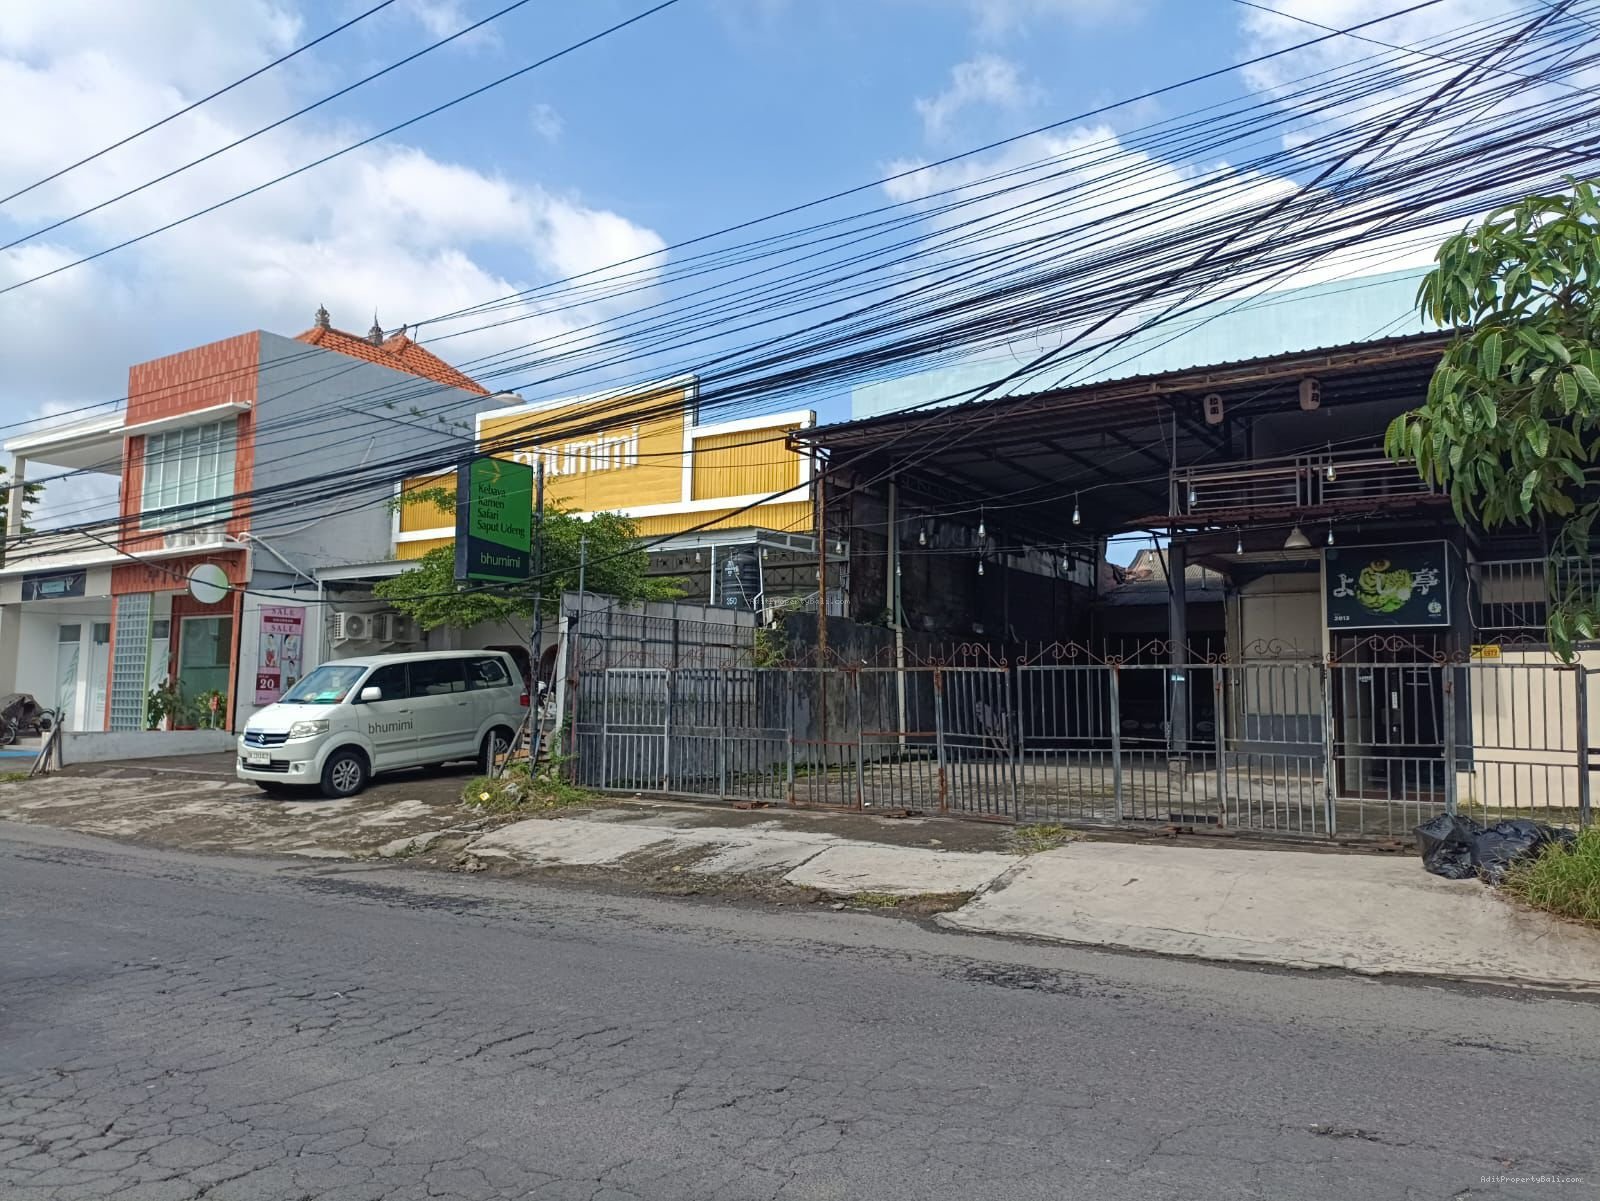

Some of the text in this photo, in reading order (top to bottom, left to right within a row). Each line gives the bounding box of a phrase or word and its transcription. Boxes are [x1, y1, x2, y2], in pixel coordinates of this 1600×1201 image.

[478, 482, 506, 499] Kebaya
[478, 496, 505, 509] Kamen
[477, 508, 499, 520] Safari
[477, 520, 525, 539] Saput Udeng
[480, 551, 521, 569] bhumimi
[272, 608, 296, 616] SALE
[271, 625, 294, 633] SALE
[260, 679, 275, 689] 20
[368, 718, 413, 735] bhumimi
